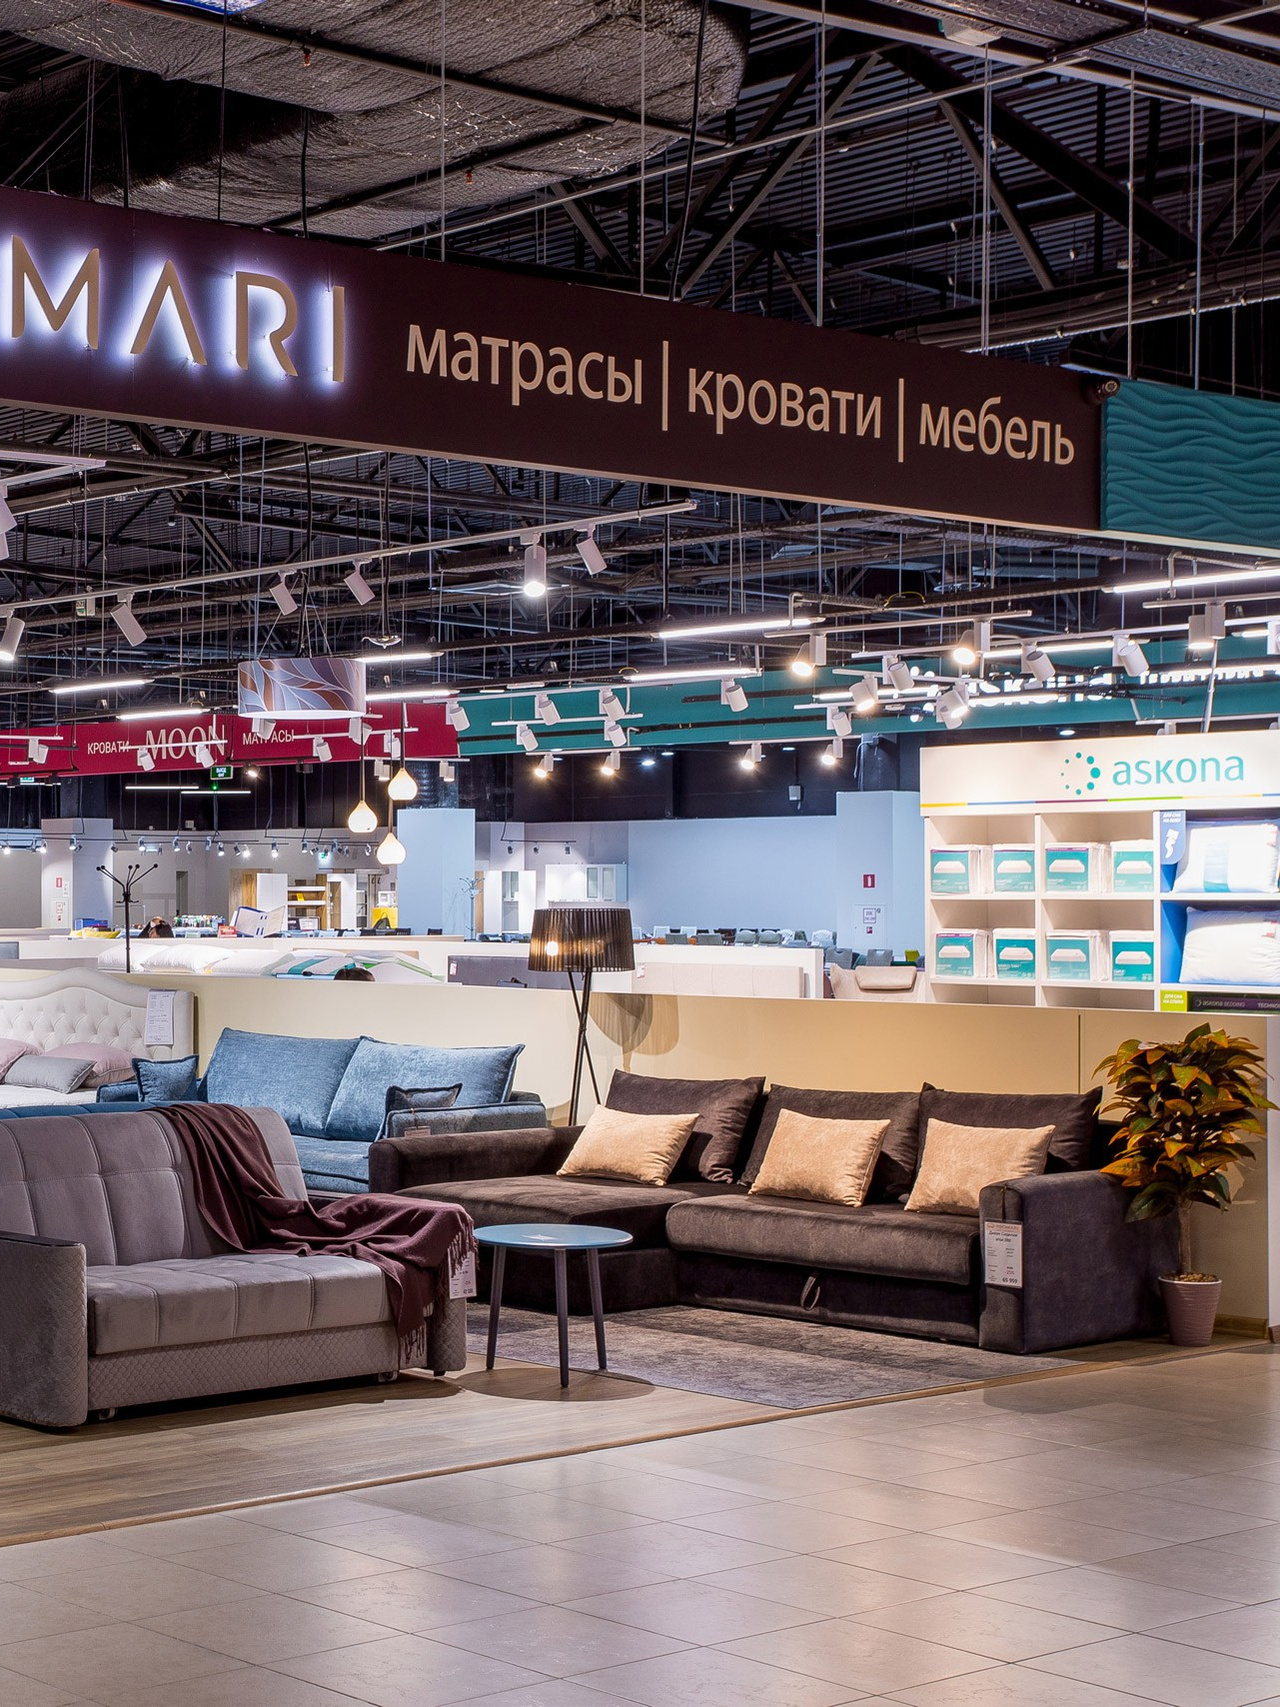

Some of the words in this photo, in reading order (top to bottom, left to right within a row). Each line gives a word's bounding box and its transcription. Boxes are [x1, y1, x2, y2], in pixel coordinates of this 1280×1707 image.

[406, 324, 642, 406] матрасы
[688, 367, 882, 434] кровати
[920, 396, 1075, 466] мебель
[87, 740, 130, 755] КРОВАТИ
[145, 723, 226, 760] MOON
[242, 729, 295, 746] МААСЫ
[1111, 754, 1245, 786] askona
